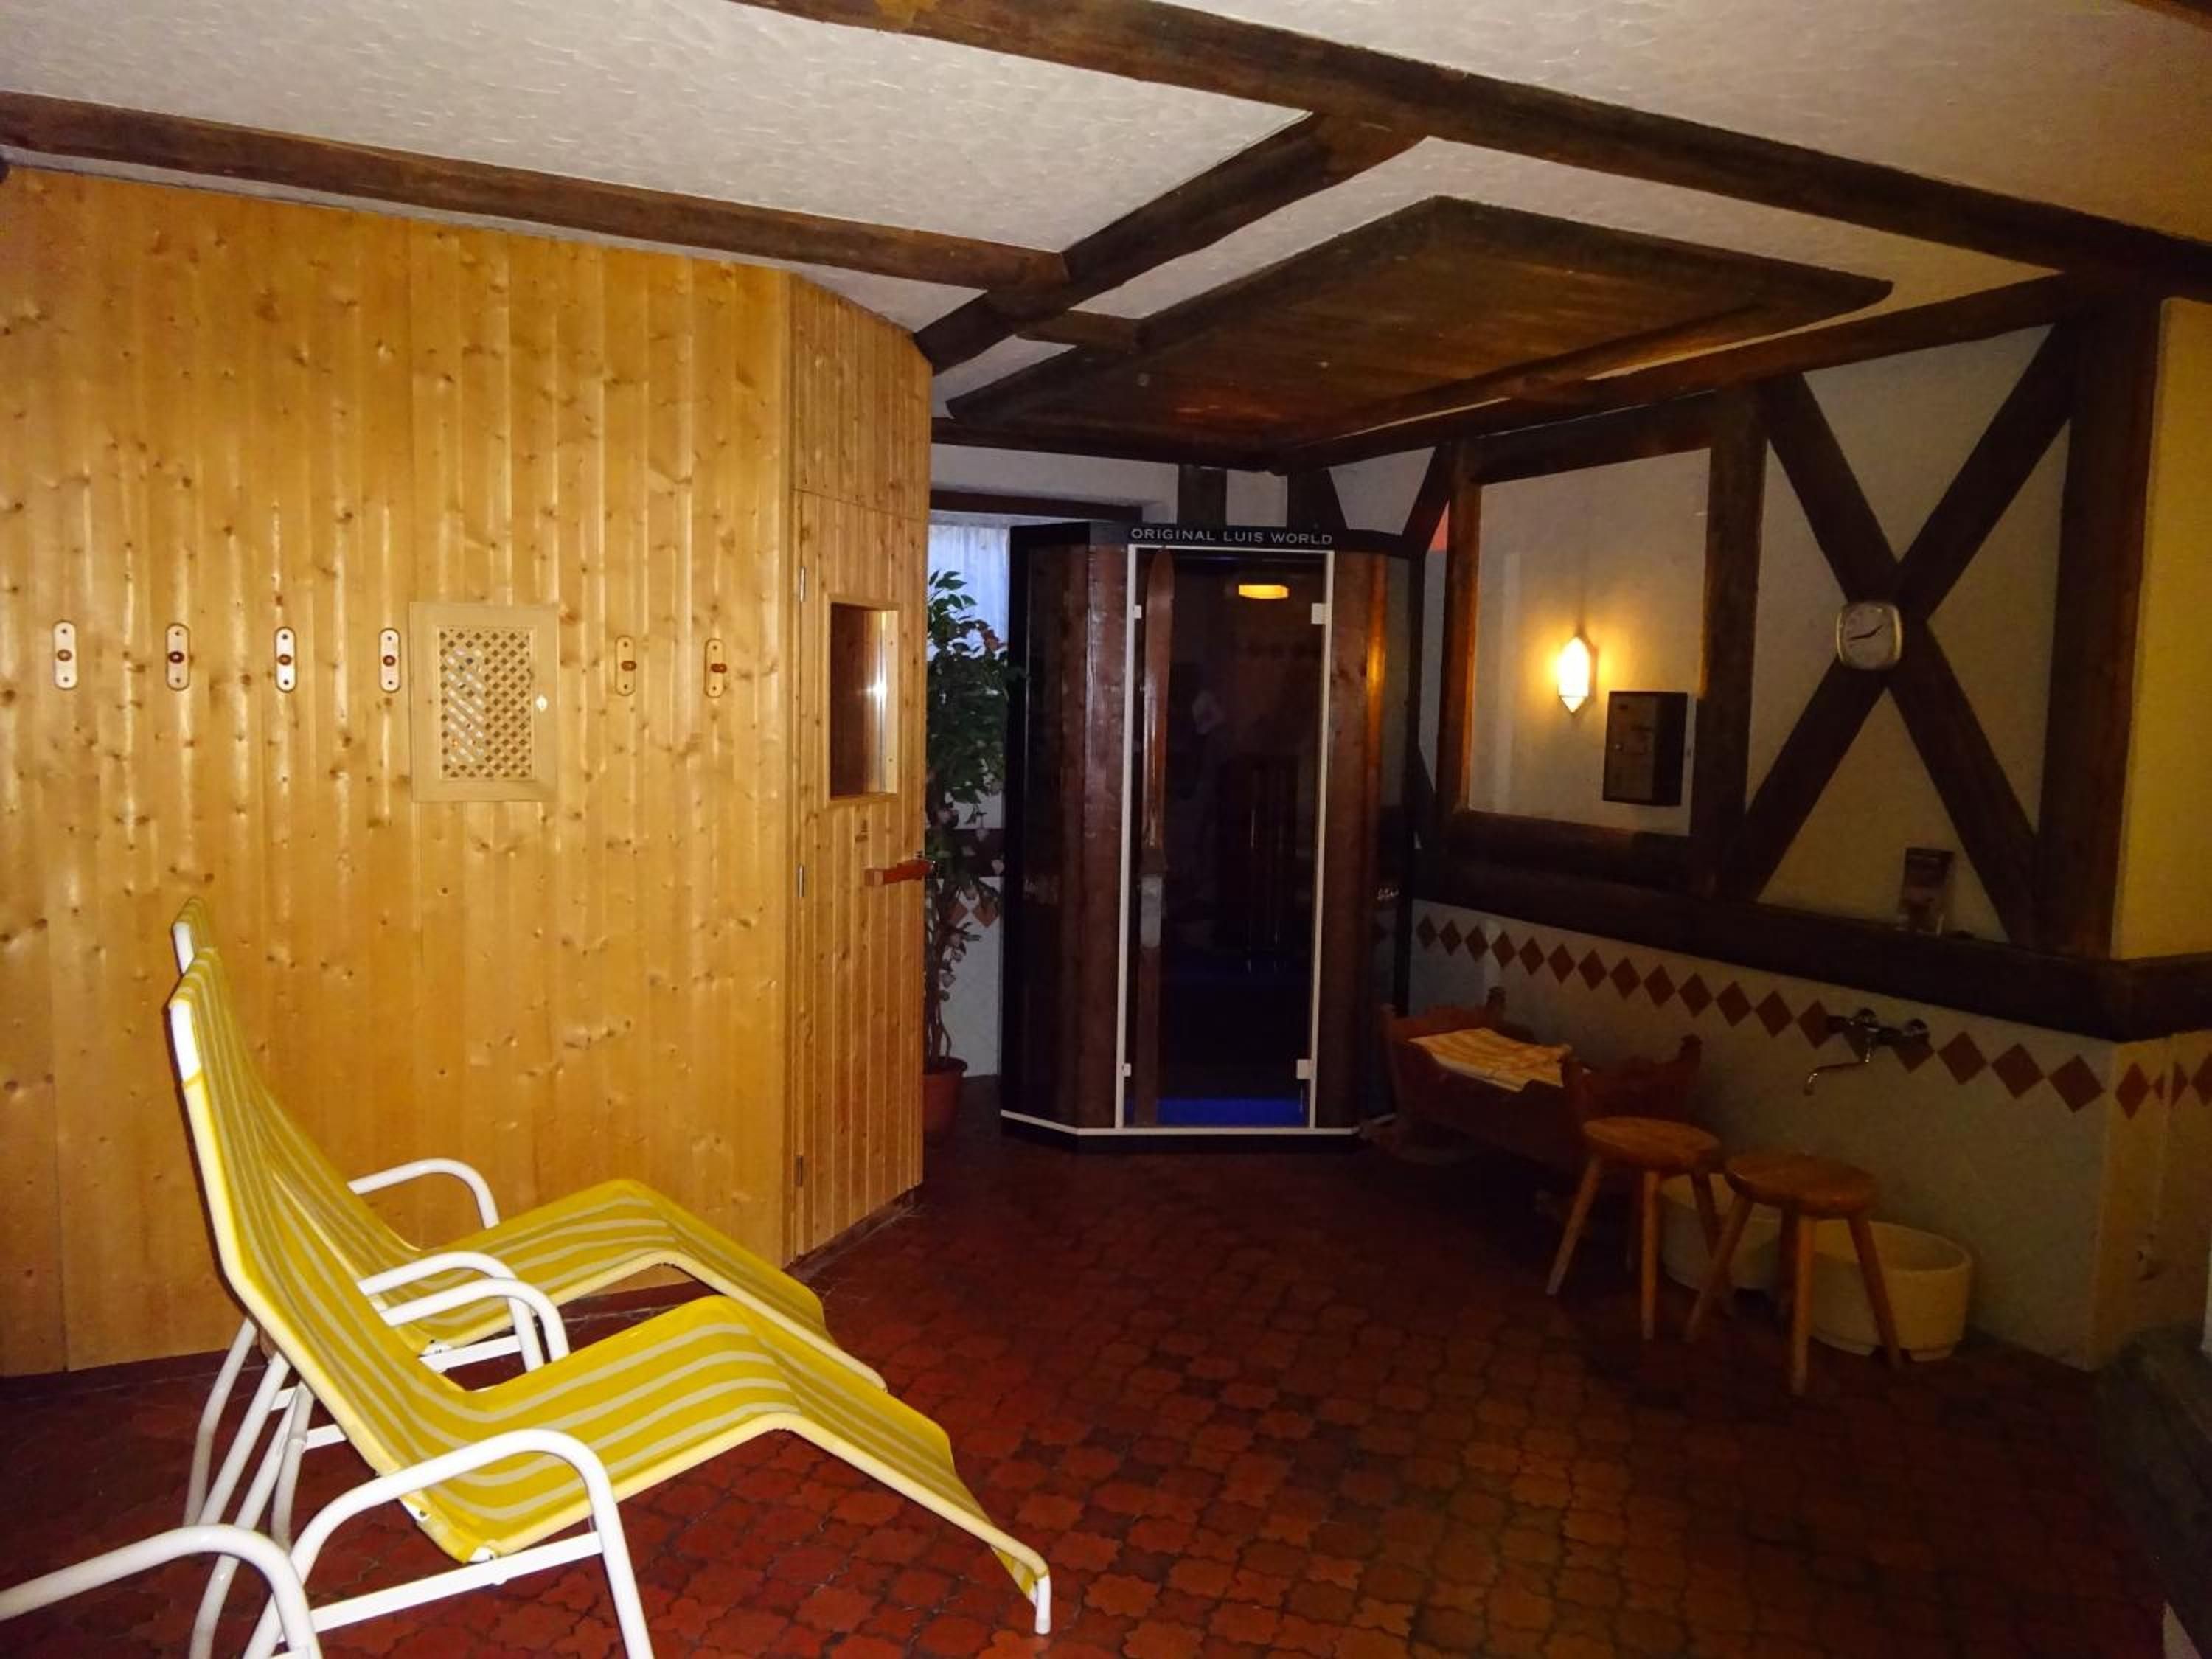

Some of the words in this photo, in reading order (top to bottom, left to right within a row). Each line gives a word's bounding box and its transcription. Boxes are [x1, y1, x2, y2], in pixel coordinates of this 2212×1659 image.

[1131, 528, 1215, 541] ORIGINAL
[1223, 531, 1263, 543] LUIS
[1271, 532, 1333, 545] WORLD
